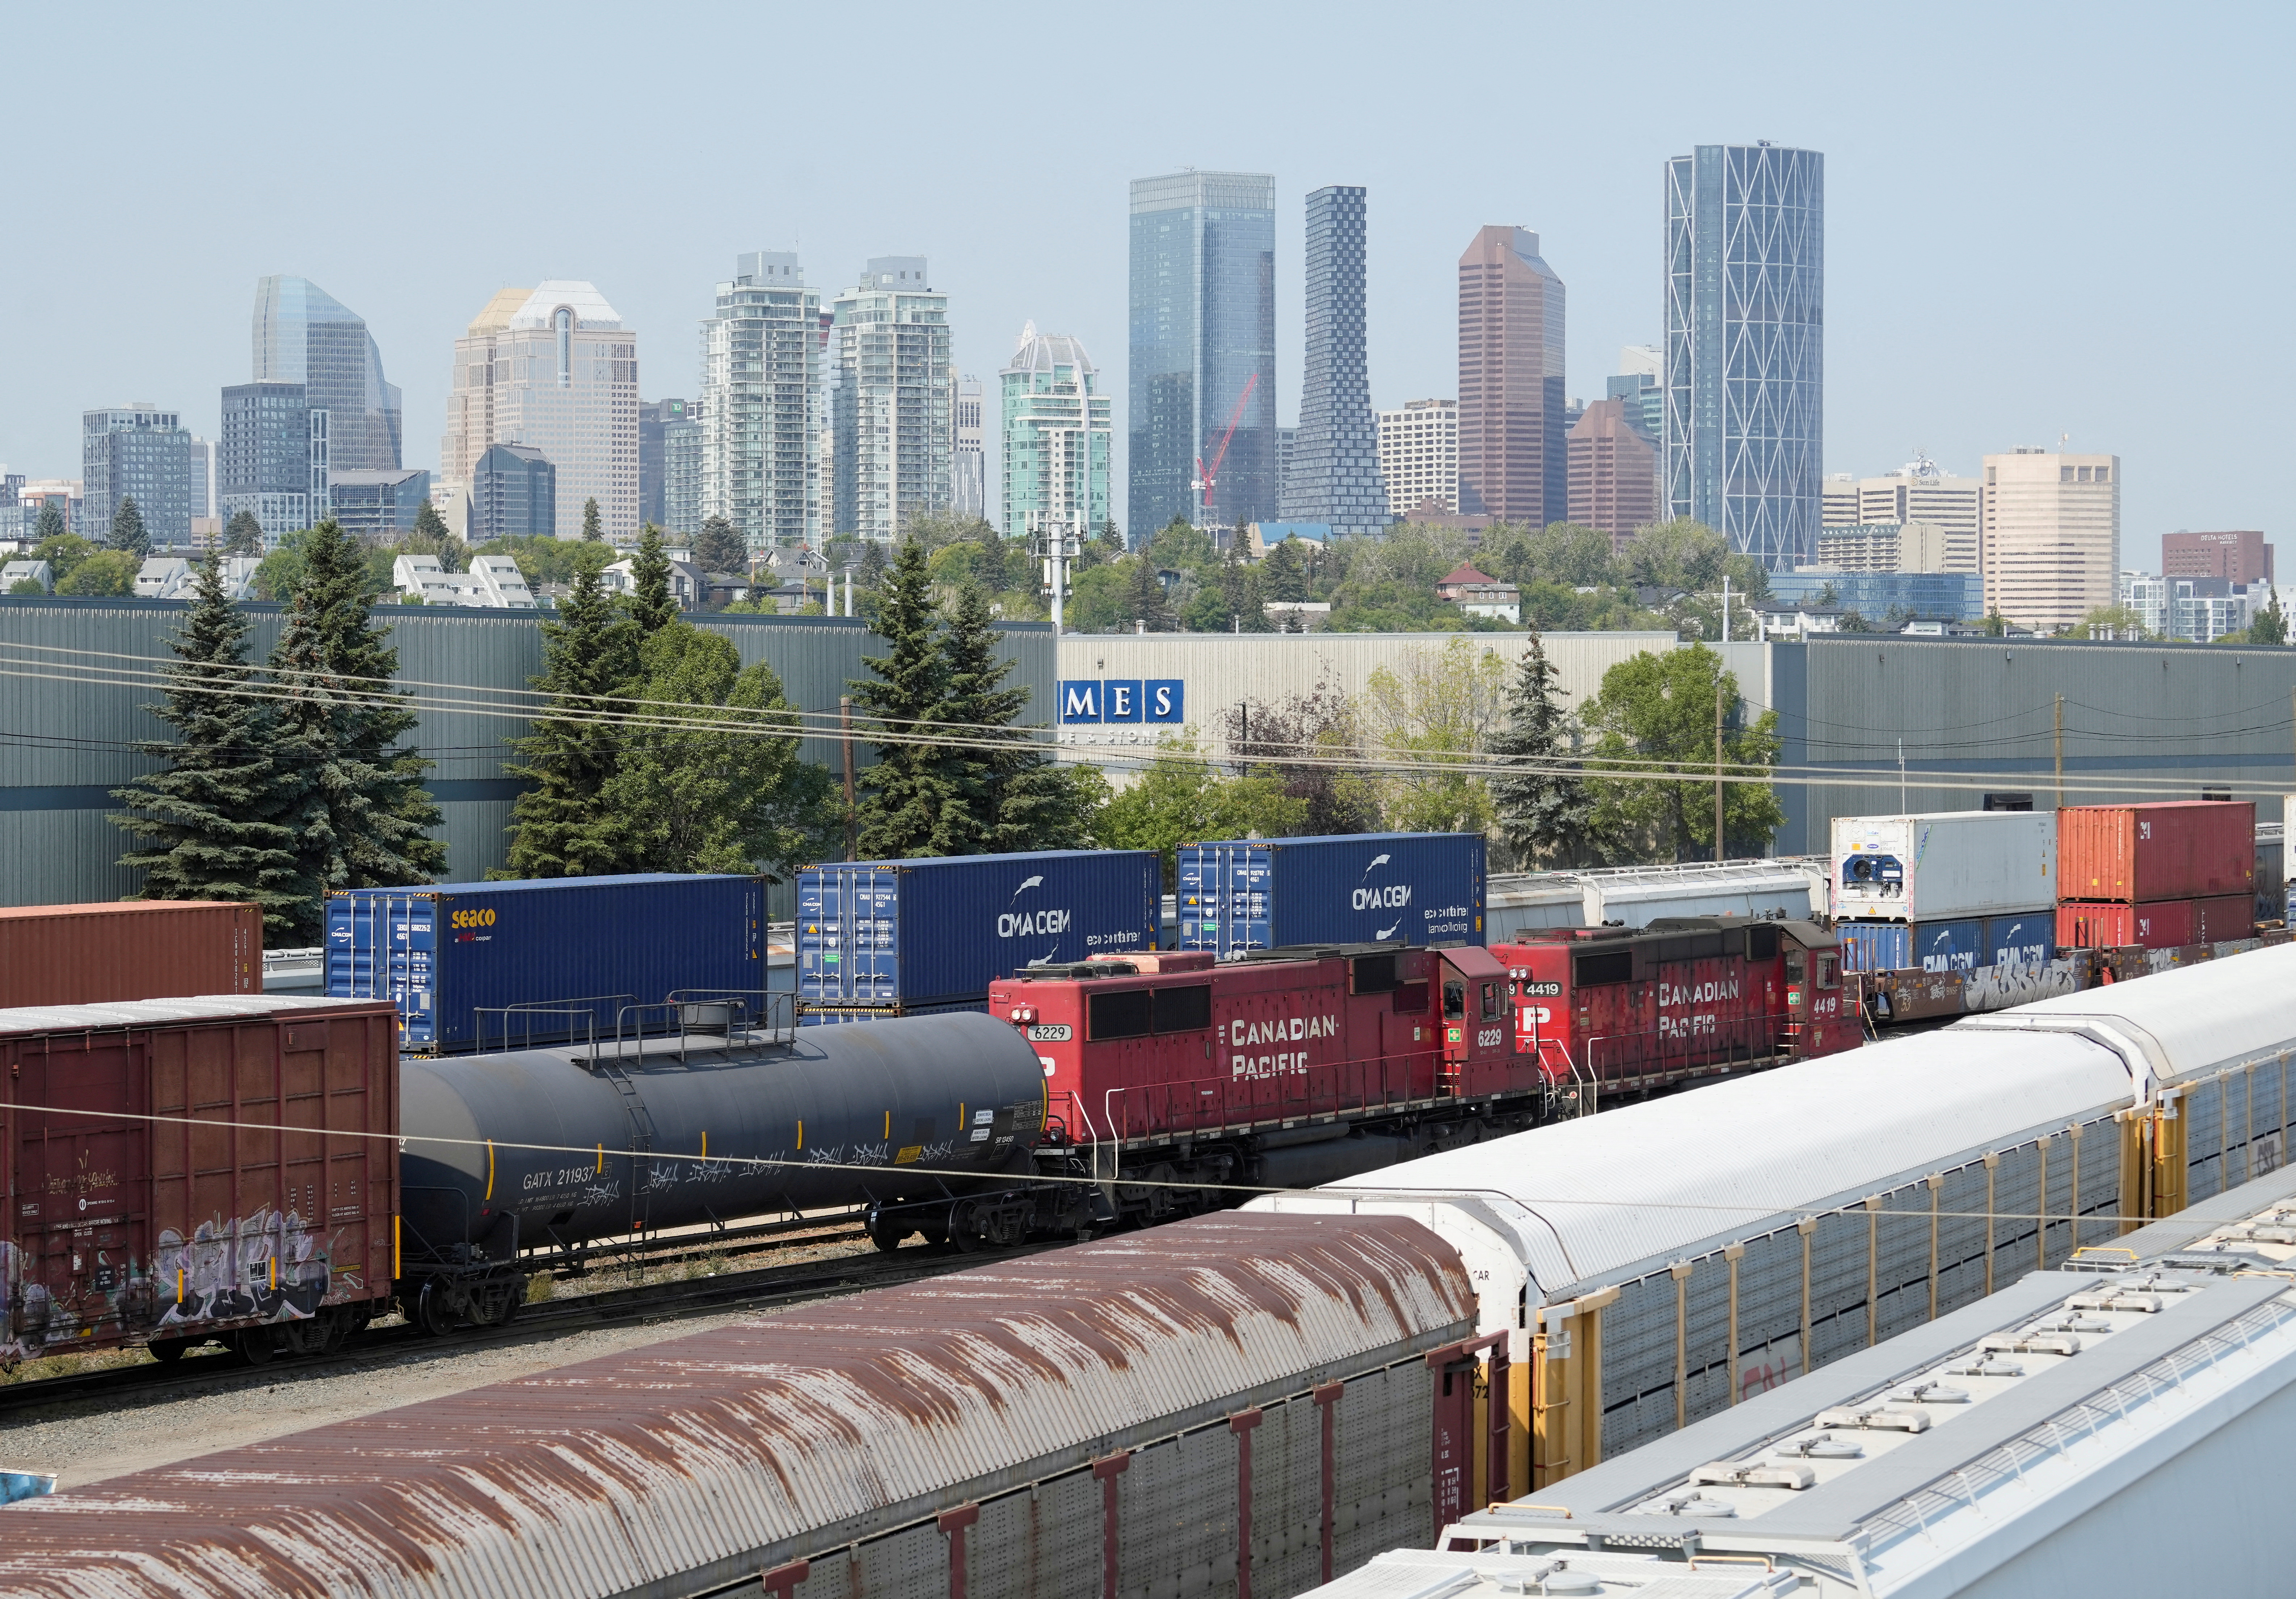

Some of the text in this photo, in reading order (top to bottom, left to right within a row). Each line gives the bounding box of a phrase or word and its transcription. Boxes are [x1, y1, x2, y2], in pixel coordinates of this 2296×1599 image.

[1087, 731, 1096, 742] &
[1352, 885, 1411, 910] CMA CGM
[451, 908, 496, 929] seaco
[998, 909, 1070, 938] CMA CGM
[1425, 909, 1436, 919] eco
[1087, 934, 1101, 946] eco
[1923, 952, 1973, 973] CMA CGM
[1997, 944, 2044, 965] CMA CGM
[1527, 983, 1559, 995] 4419
[1659, 979, 1738, 1007] CANADIAN
[1946, 986, 1958, 995] BNSF
[1814, 997, 1836, 1013] 4419
[1901, 997, 1912, 1012] 53
[1035, 1026, 1065, 1039] 6229
[1232, 1014, 1335, 1046] CANADIAN
[1659, 1014, 1715, 1039] PACIFIC
[1478, 1028, 1502, 1047] 6229
[1233, 1052, 1308, 1082] PACIFIC
[523, 1165, 596, 1190] GATX 211937
